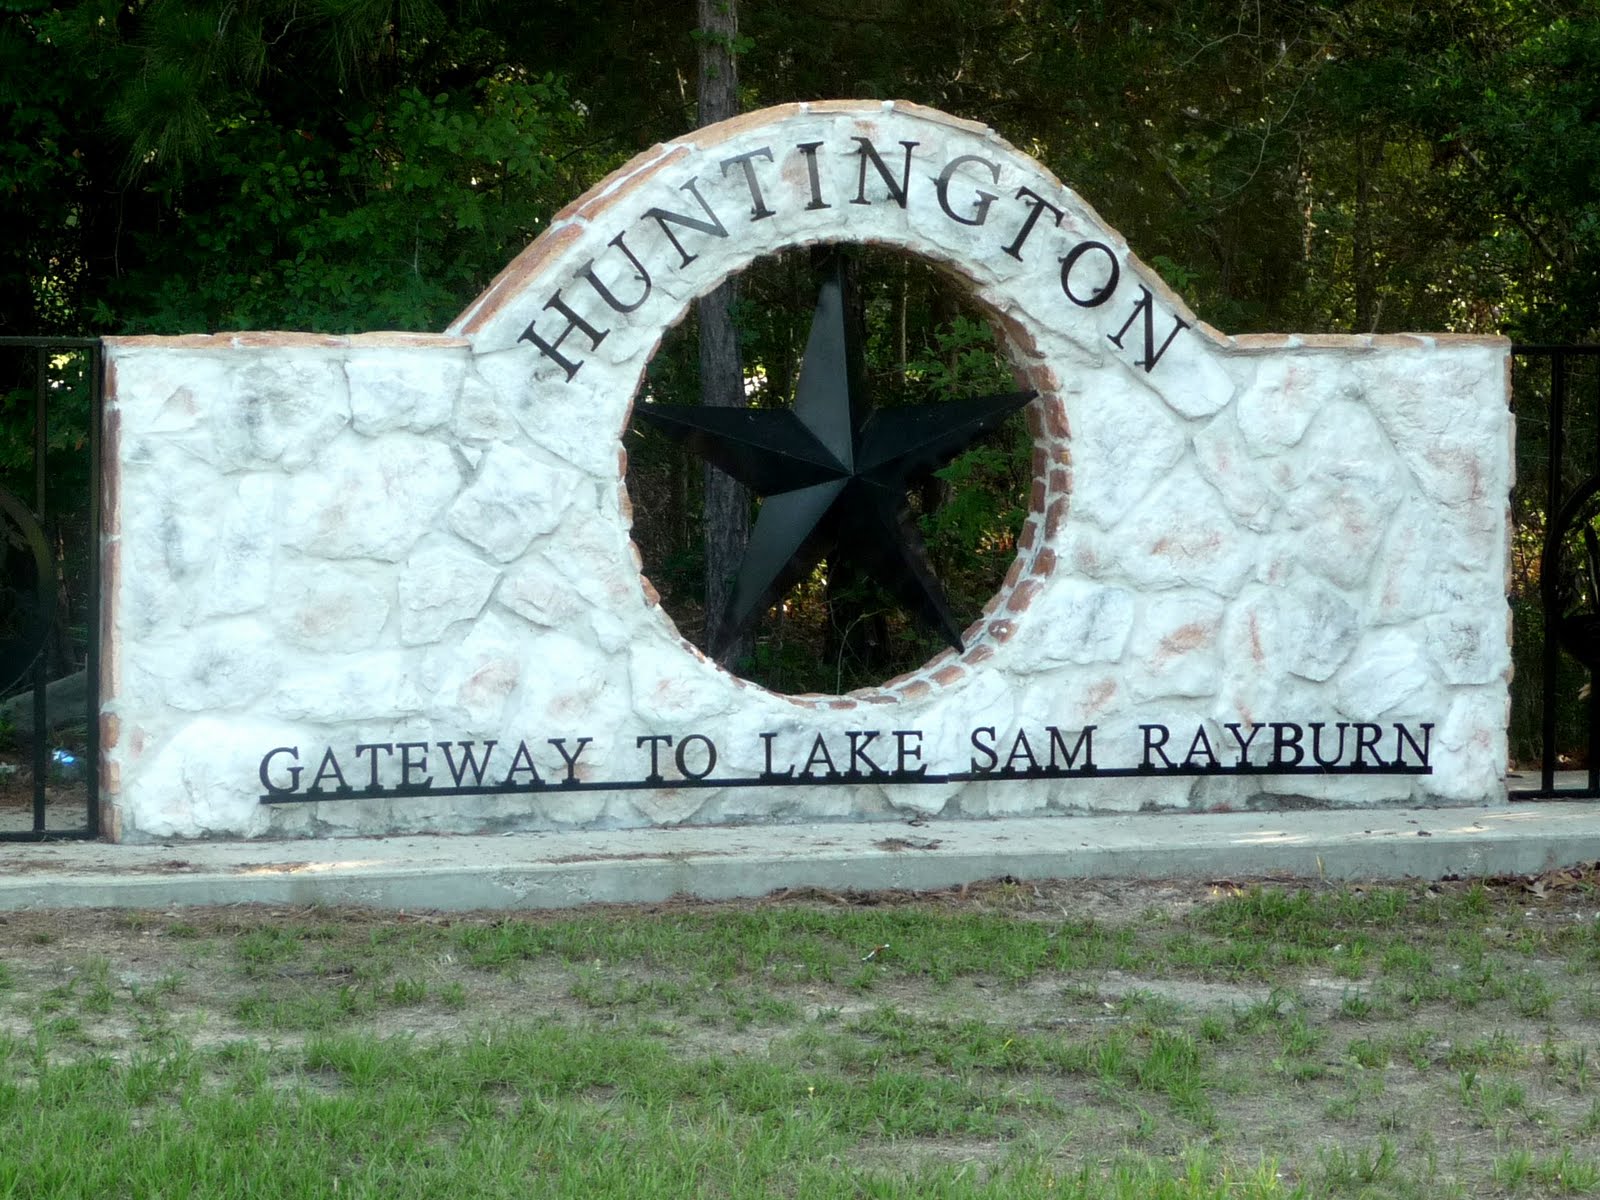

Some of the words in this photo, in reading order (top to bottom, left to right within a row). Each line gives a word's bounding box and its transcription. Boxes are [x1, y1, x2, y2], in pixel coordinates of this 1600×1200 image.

[517, 136, 1191, 382] HUNTINGTON
[259, 736, 593, 794] GATEWAY
[636, 734, 718, 784] TO
[759, 730, 927, 780] LAKE
[970, 725, 1097, 775] SAM
[1138, 722, 1435, 772] RAYBURN
